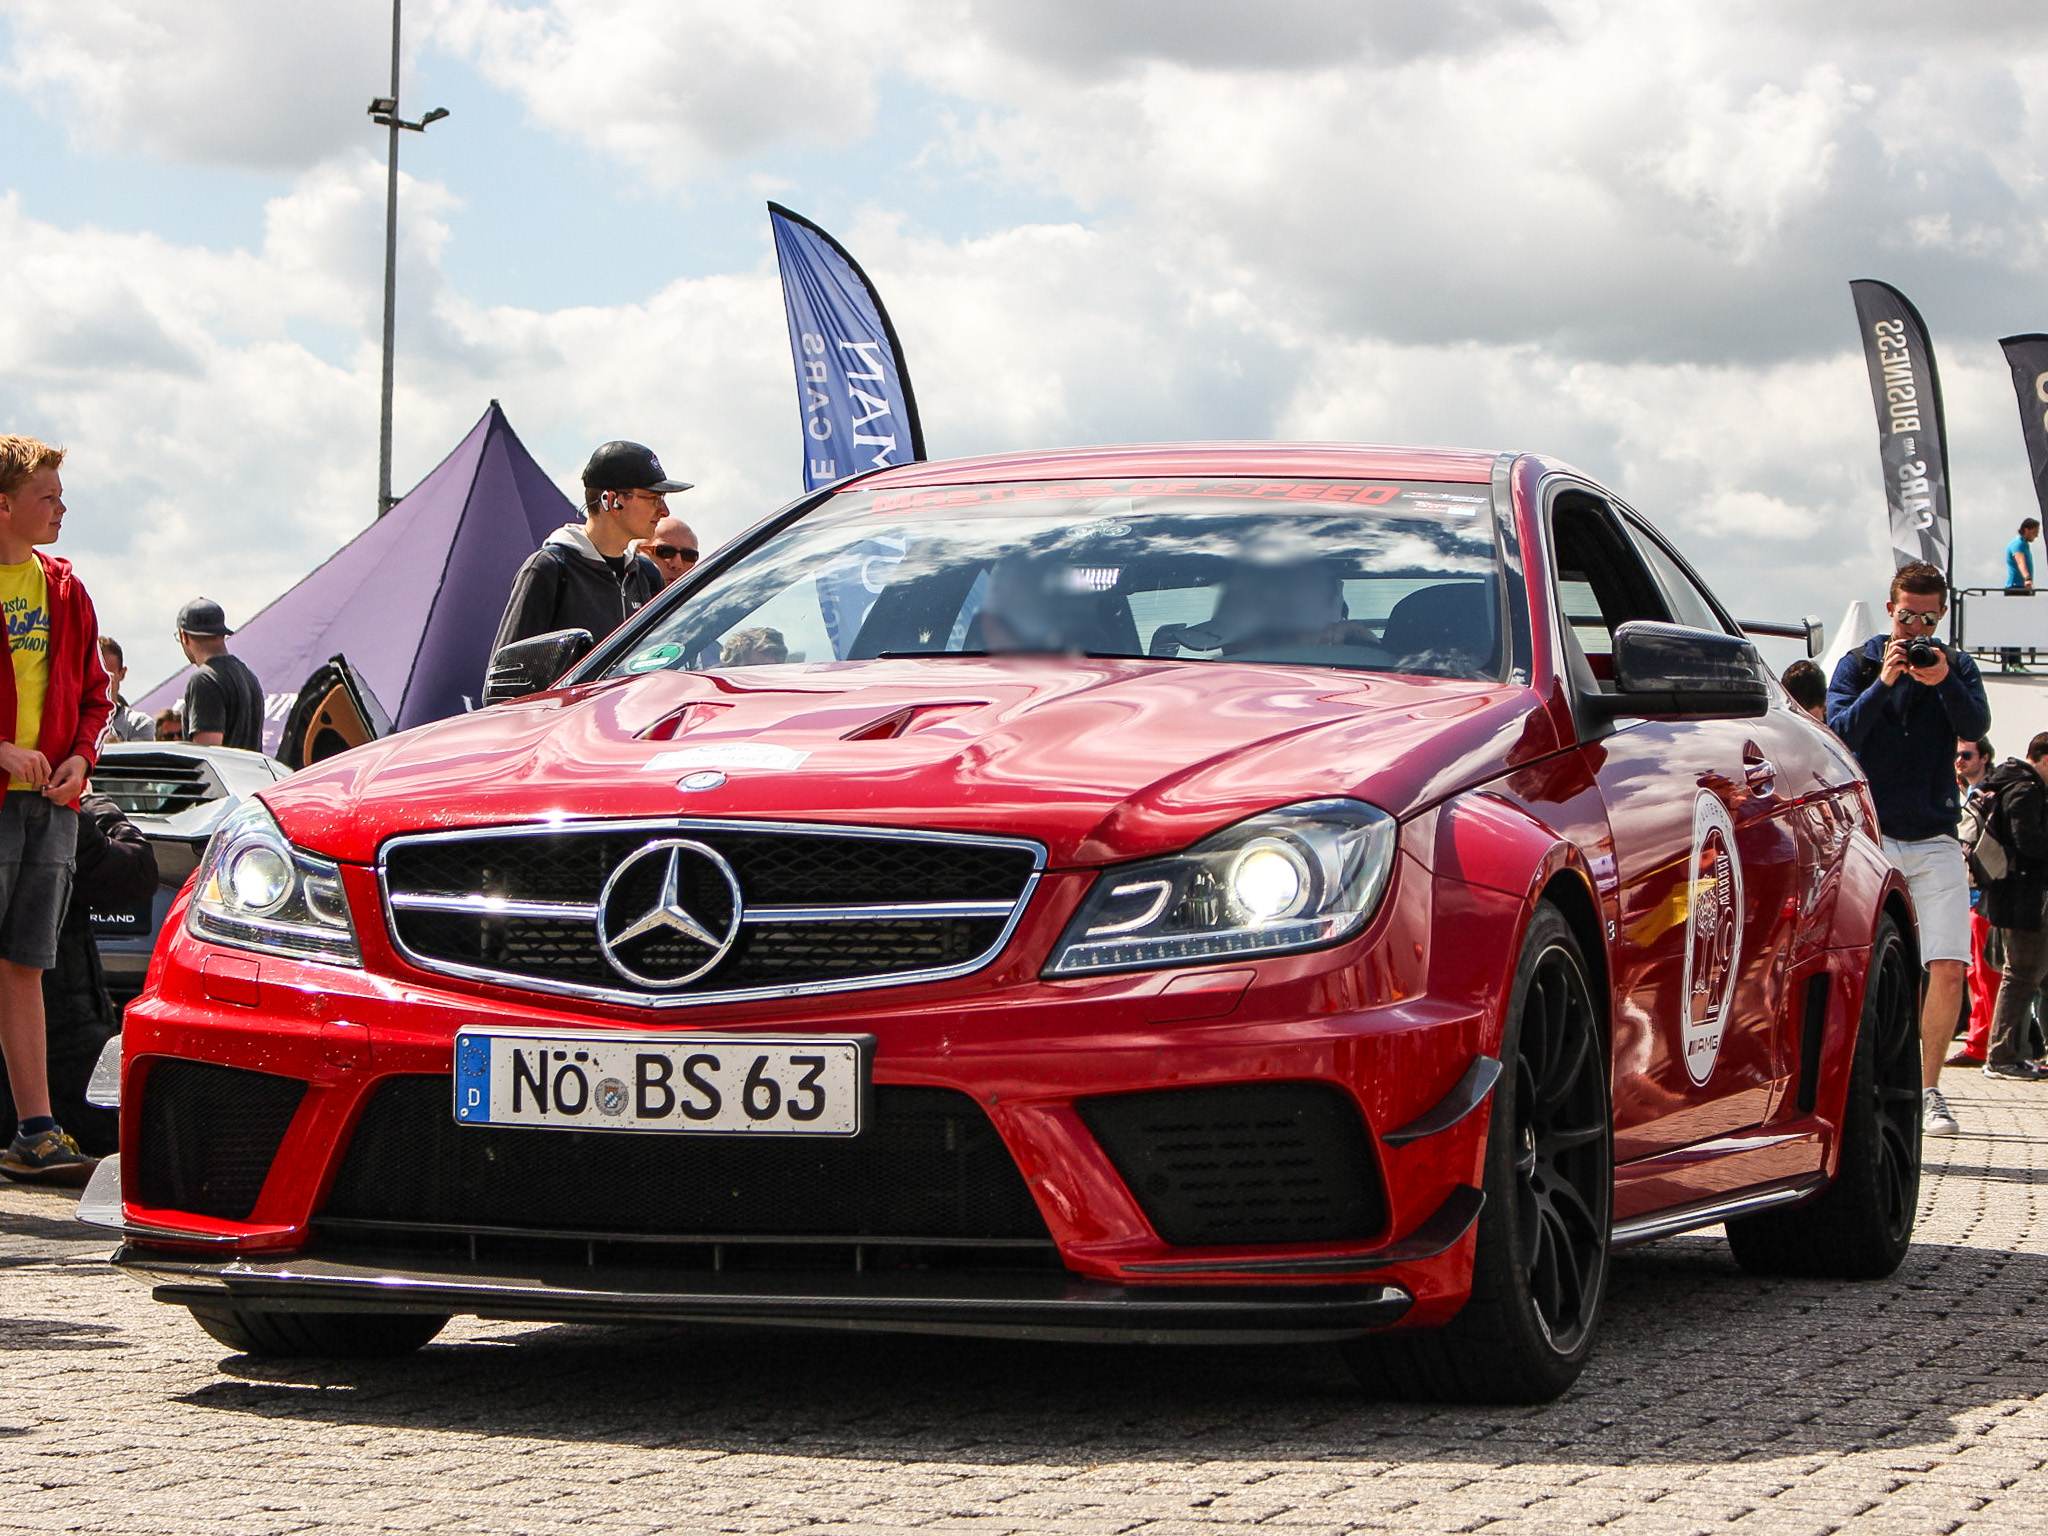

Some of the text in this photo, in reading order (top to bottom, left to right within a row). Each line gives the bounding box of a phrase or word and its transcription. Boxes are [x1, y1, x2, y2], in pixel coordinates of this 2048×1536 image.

[871, 484, 1116, 513] MASTERS
[1129, 482, 1201, 494] OF
[1204, 482, 1403, 505] SPEED
[89, 913, 136, 923] RLAND
[467, 1088, 481, 1106] D
[512, 1048, 590, 1116] NÖ
[635, 1053, 722, 1121] BS
[742, 1055, 828, 1122] 63
